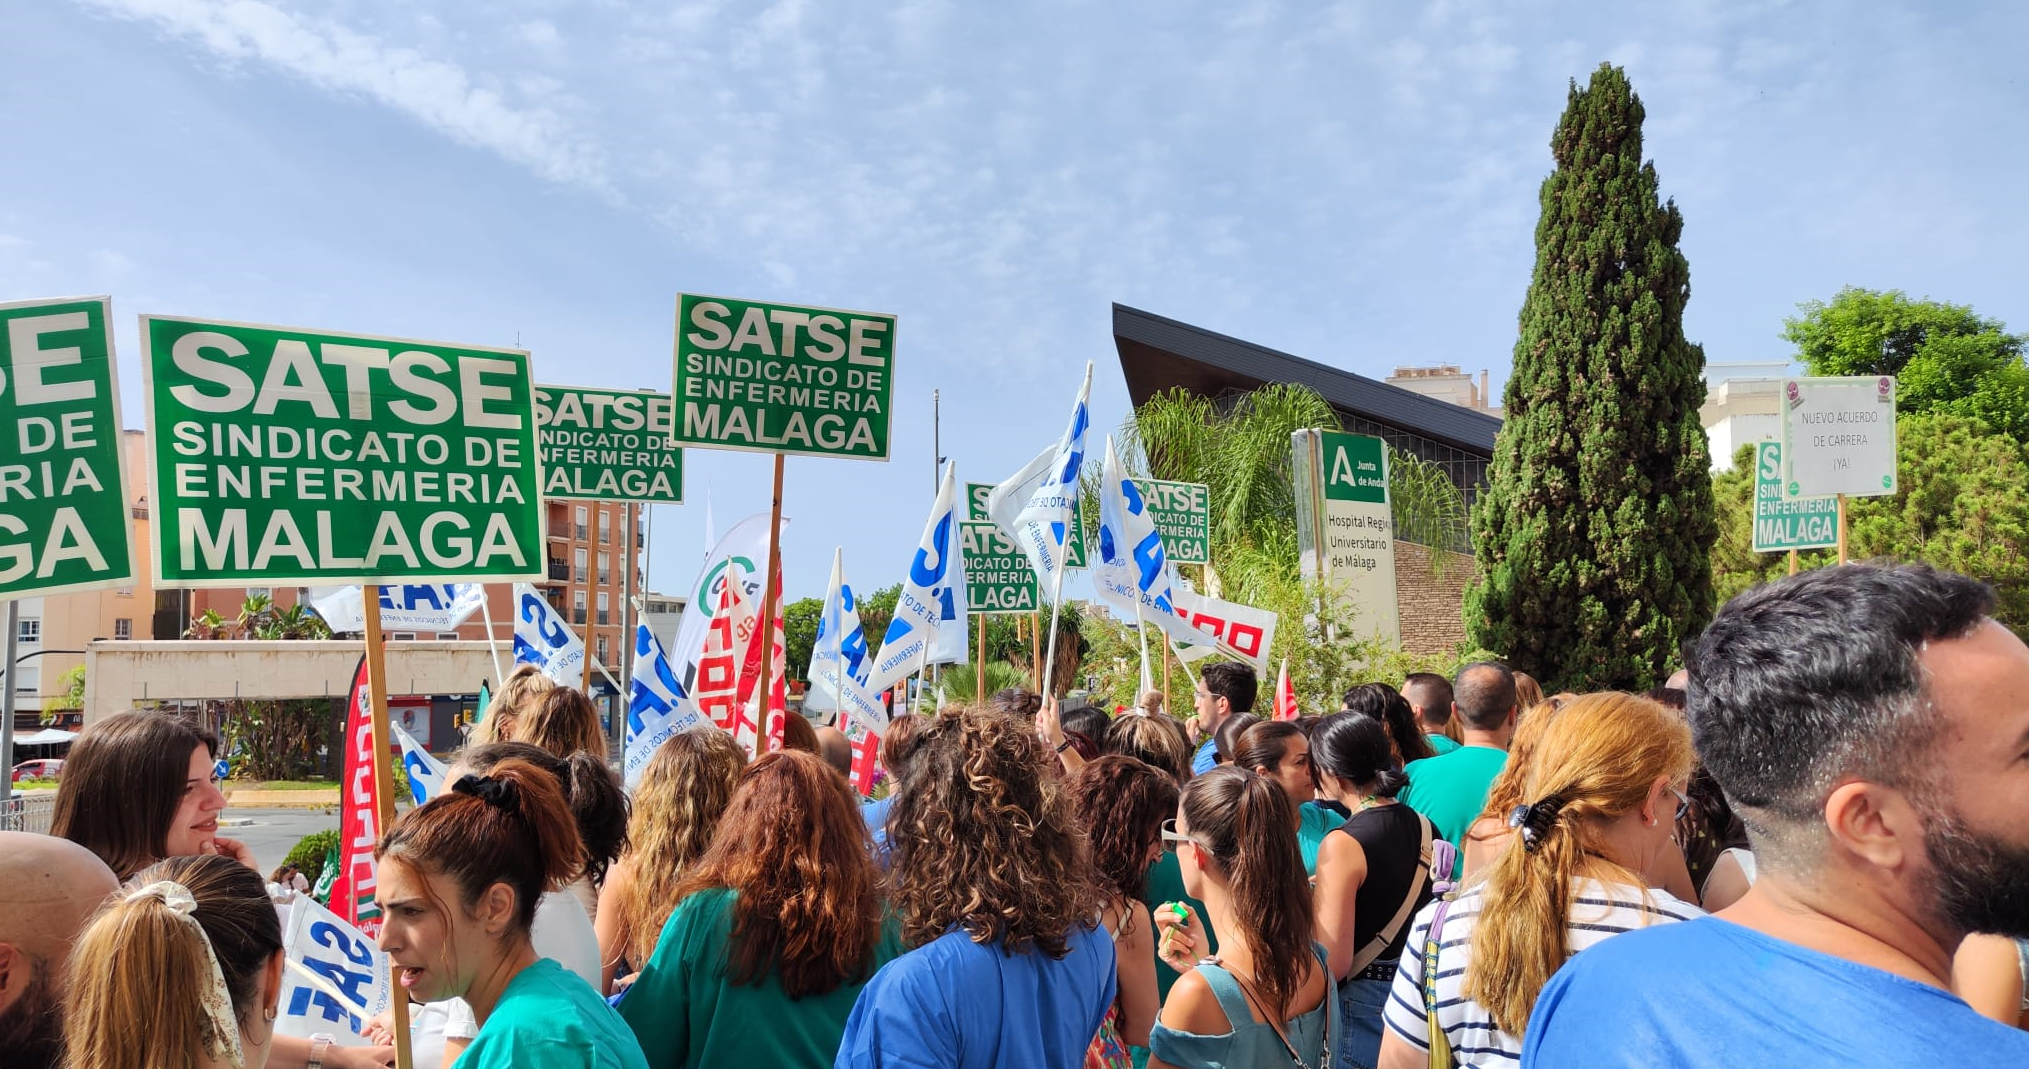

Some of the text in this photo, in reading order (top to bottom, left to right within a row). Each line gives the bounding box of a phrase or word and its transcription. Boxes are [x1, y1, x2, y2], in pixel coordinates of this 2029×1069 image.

[687, 301, 887, 368] SATSE
[0, 311, 97, 407] E
[169, 331, 522, 430] SATSE
[686, 353, 882, 391] SINDICATO DE
[686, 378, 881, 414] ENFERMERIA
[535, 390, 671, 433] SATSE
[1802, 411, 1878, 424] NUEVO ACUERDO
[17, 411, 97, 455] DE
[683, 401, 878, 453] MALAGA
[173, 420, 522, 469] SINDICATO DE
[540, 430, 676, 451] NDICATO DE
[1814, 435, 1868, 447] DE CARRERA
[540, 448, 676, 468] NFERMERIA
[1357, 460, 1376, 471] Junta
[176, 463, 525, 505] ENFERMERIA
[542, 466, 675, 498] ALAGA
[1358, 476, 1367, 486] de
[1760, 499, 1836, 515] ENFERMERIA
[1190, 515, 1205, 526] DE
[1329, 514, 1365, 530] Hospital
[1759, 516, 1834, 545] MALAGA
[178, 507, 527, 571] MALAGA
[1166, 538, 1205, 560] AGA
[1331, 536, 1387, 549] Universitario
[1015, 558, 1034, 570] DE
[1332, 553, 1376, 572] de Málaga
[966, 571, 1034, 584] ERMERIA
[968, 586, 1033, 609] LAGA
[912, 602, 926, 616] DE
[843, 687, 852, 698] DE
